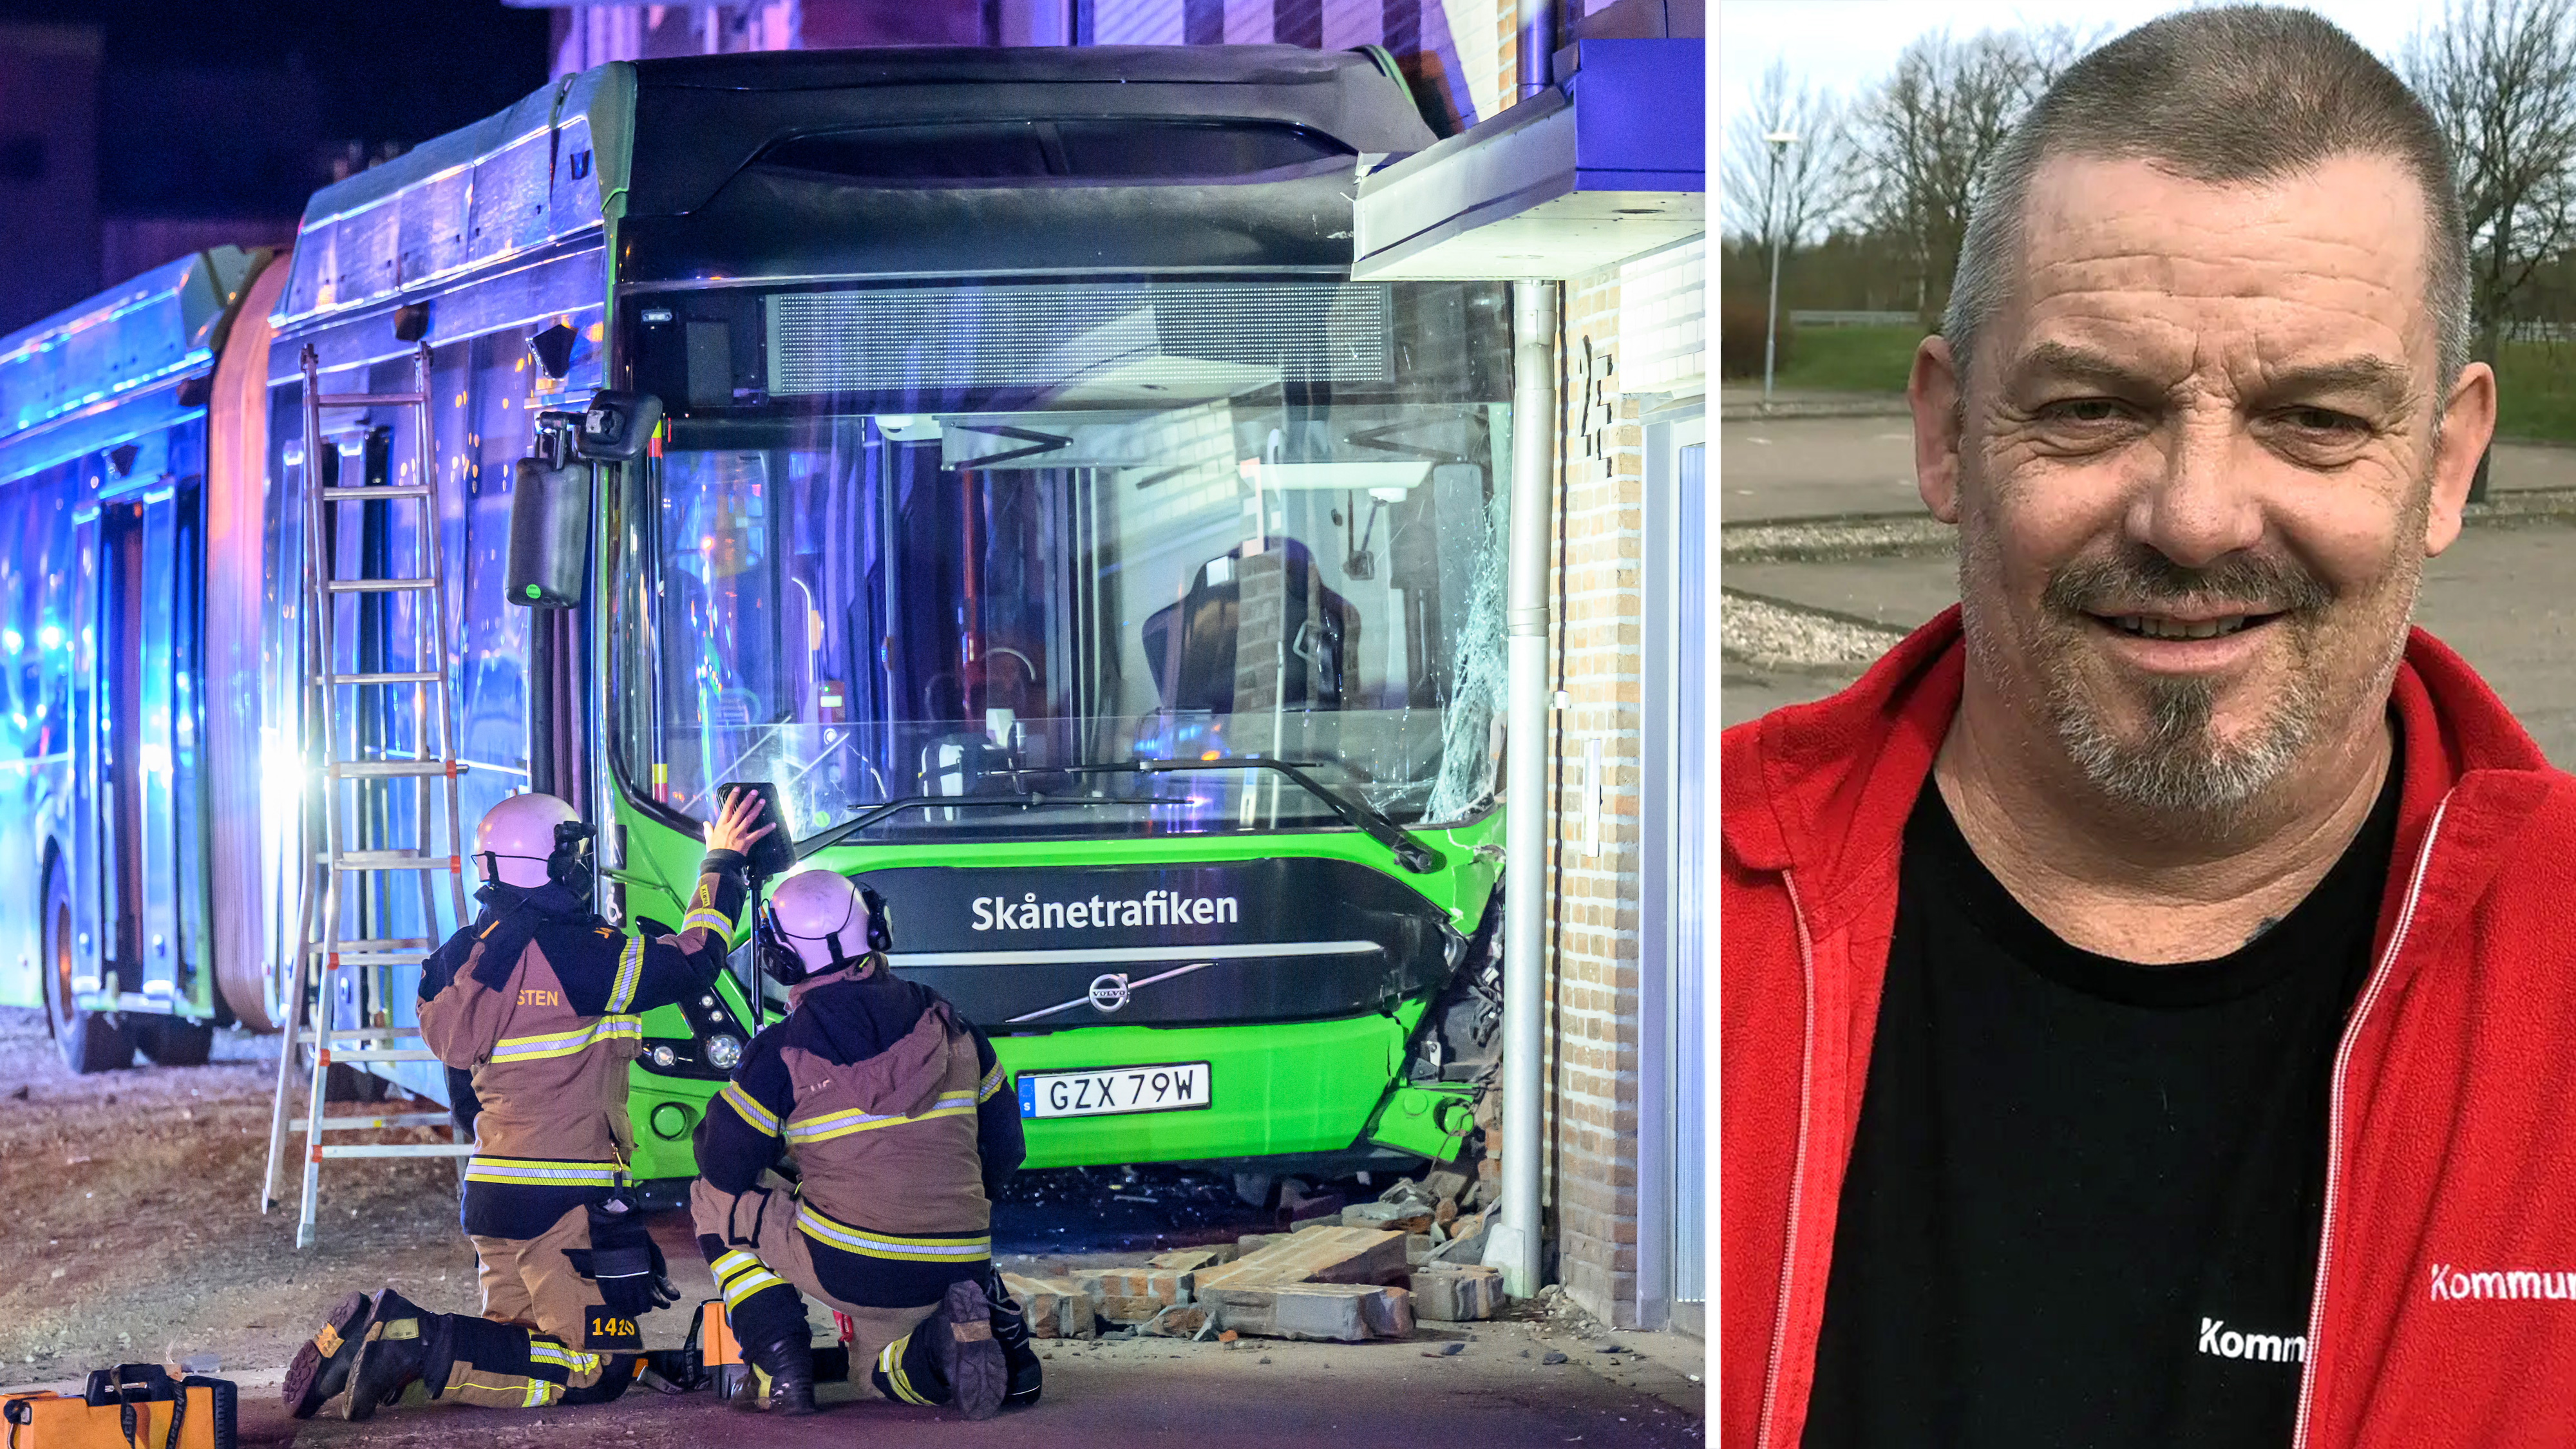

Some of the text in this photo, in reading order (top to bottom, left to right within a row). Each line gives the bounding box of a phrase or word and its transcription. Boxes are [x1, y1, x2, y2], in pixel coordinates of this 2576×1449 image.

[971, 890, 1238, 931] Skånetrafiken
[1023, 1102, 1031, 1112] S
[1050, 1070, 1193, 1110] GZX 79W
